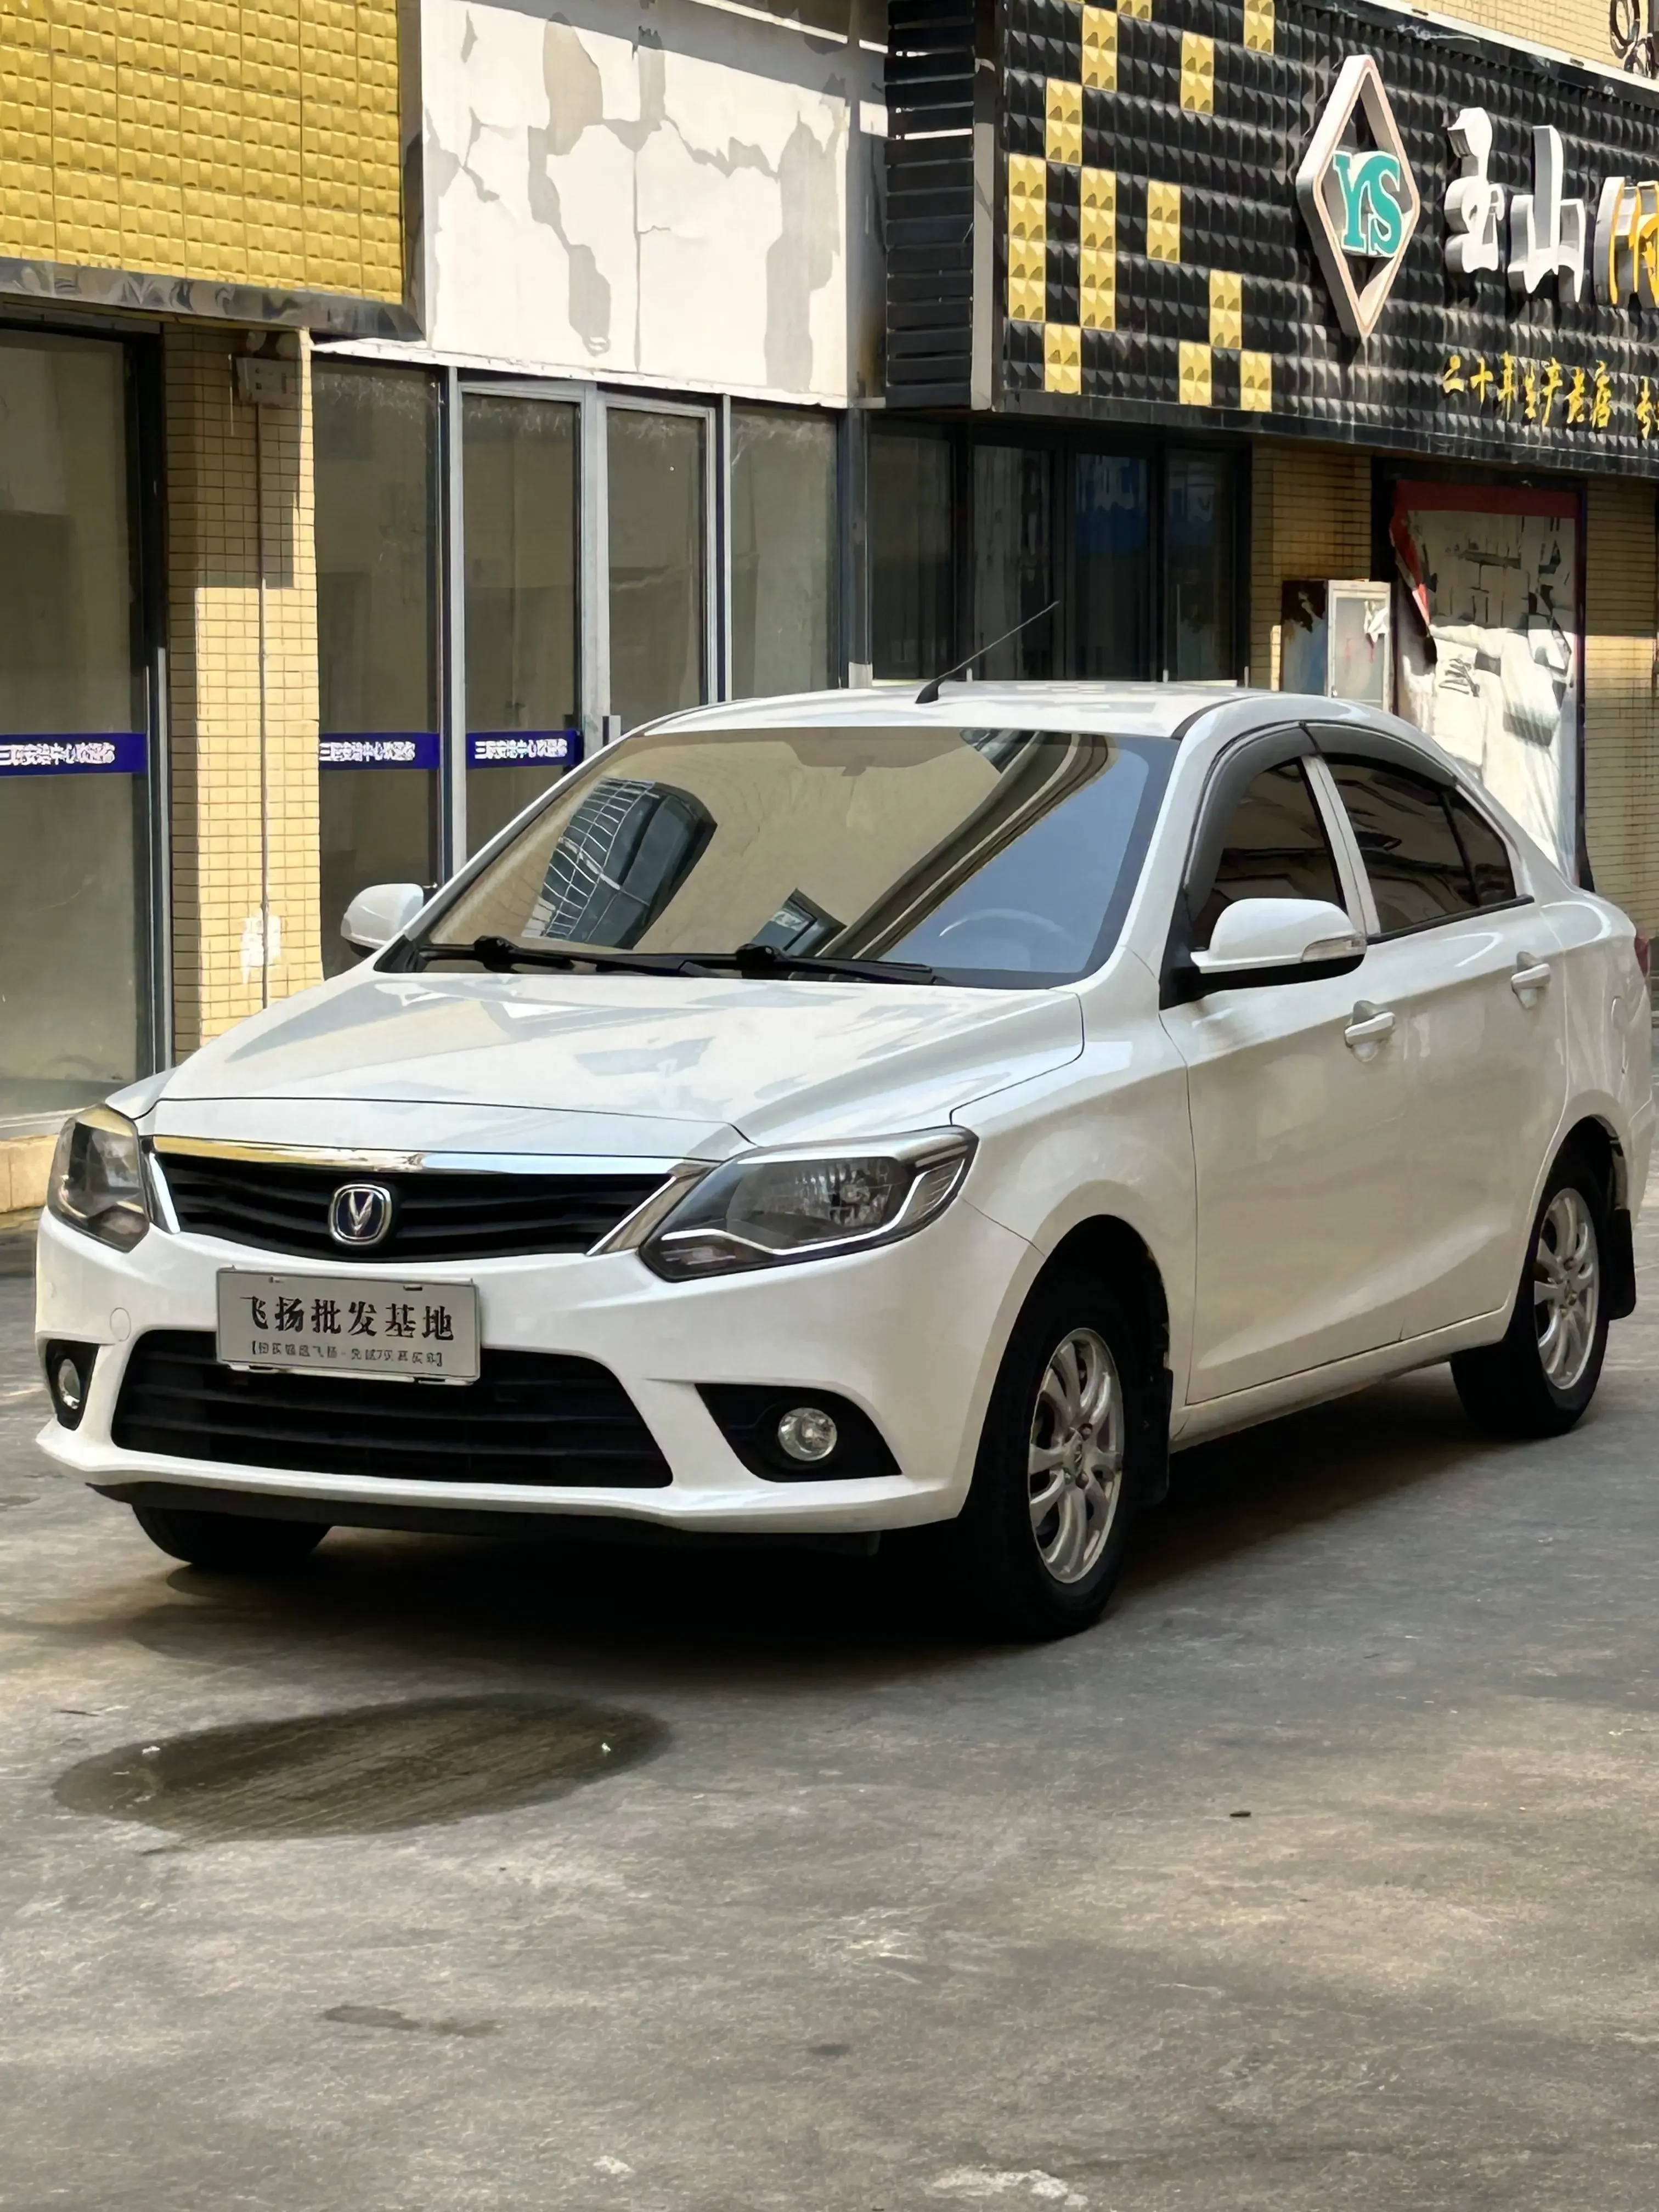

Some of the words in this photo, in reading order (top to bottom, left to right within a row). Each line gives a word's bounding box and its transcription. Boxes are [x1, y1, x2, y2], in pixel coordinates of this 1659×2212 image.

[1333, 150, 1402, 258] YS
[240, 1295, 455, 1341] 飞扬批发基地
